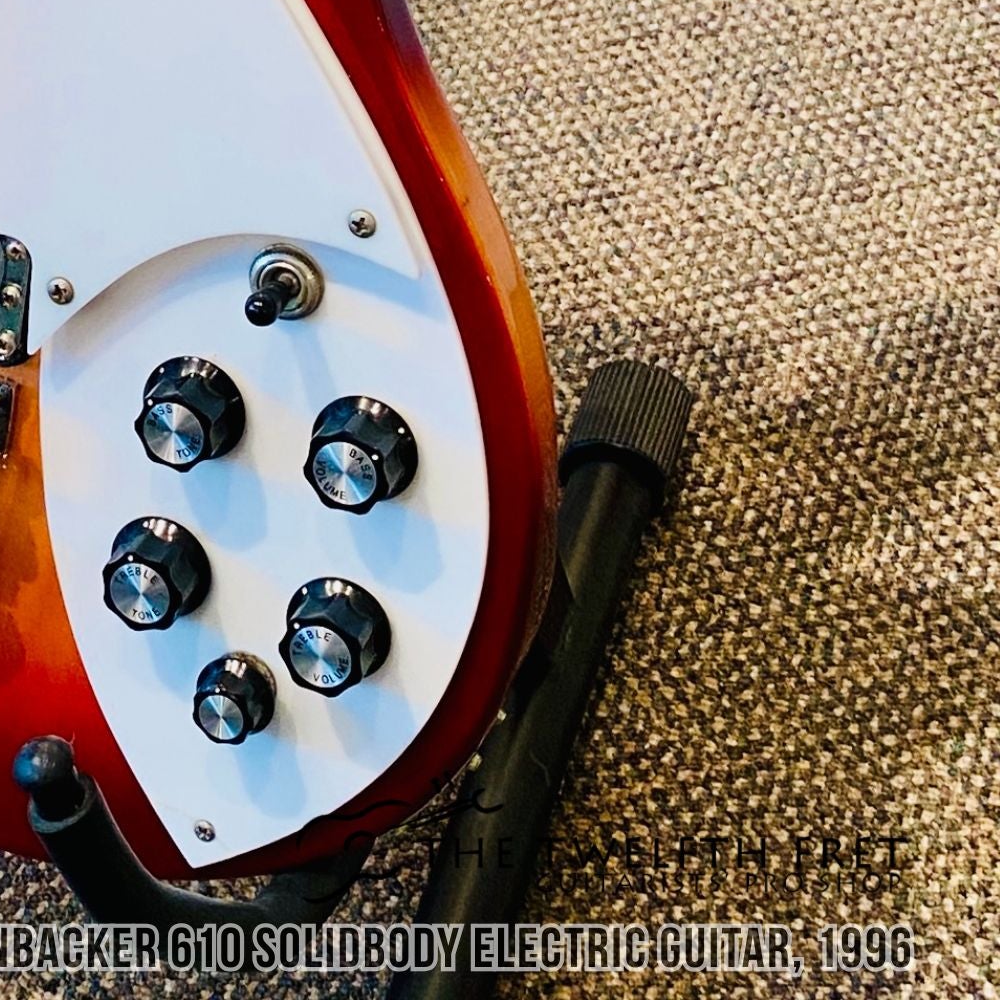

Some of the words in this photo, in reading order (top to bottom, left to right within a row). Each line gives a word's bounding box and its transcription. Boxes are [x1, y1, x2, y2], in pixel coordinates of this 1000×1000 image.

[146, 403, 173, 427] BASS
[176, 433, 200, 458] TONE
[349, 448, 373, 480] BASS
[315, 459, 347, 499] VOLUME
[114, 566, 159, 585] TREBLE
[132, 608, 161, 621] TONE
[292, 630, 332, 656] TREBLE
[313, 656, 350, 685] VOLUME
